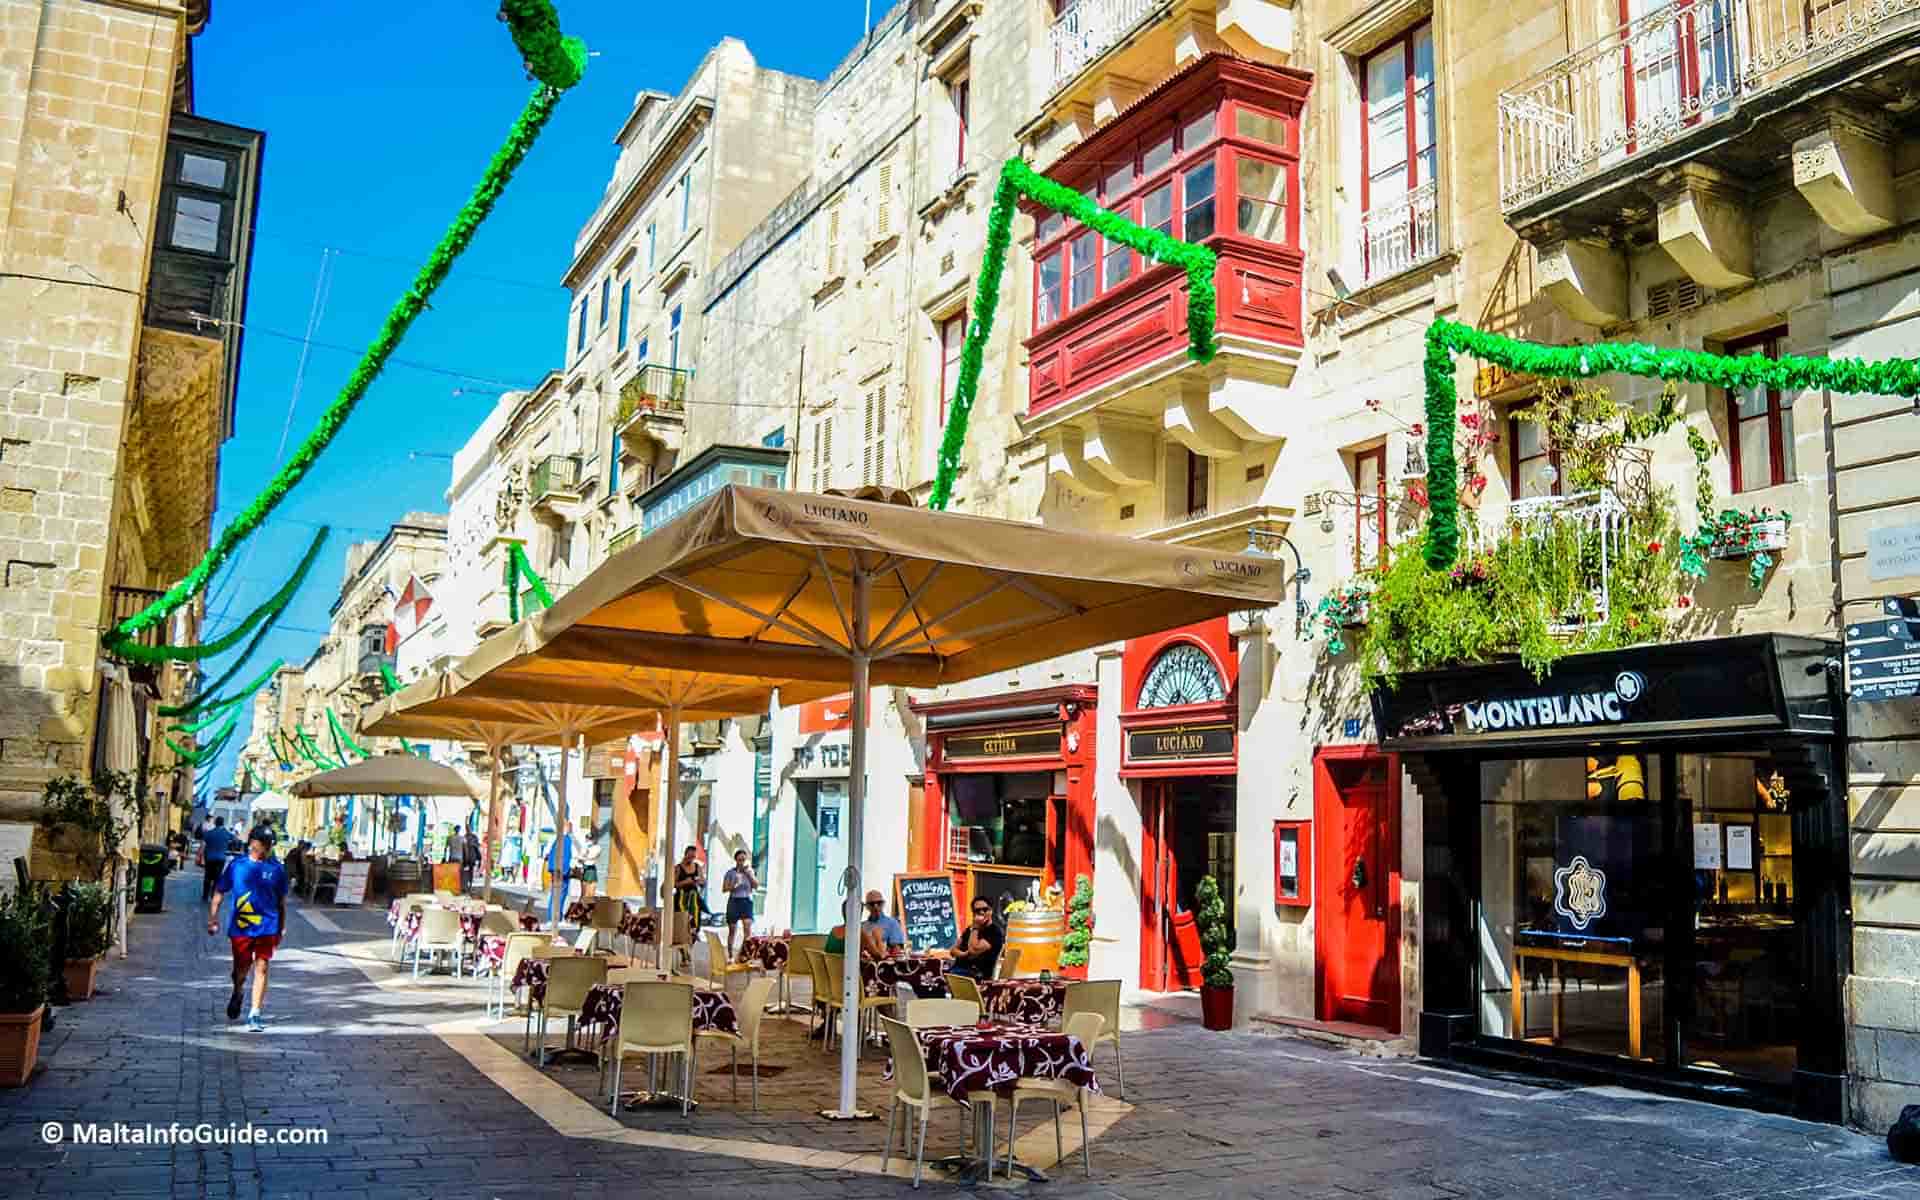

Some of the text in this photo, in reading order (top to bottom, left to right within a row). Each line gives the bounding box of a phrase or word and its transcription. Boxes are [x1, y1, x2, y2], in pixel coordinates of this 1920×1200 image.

[804, 504, 868, 523] LUCIANO
[1213, 559, 1264, 576] LUCIANO
[1464, 692, 1622, 729] MONTBLANC
[1156, 735, 1204, 751] LUCIANO
